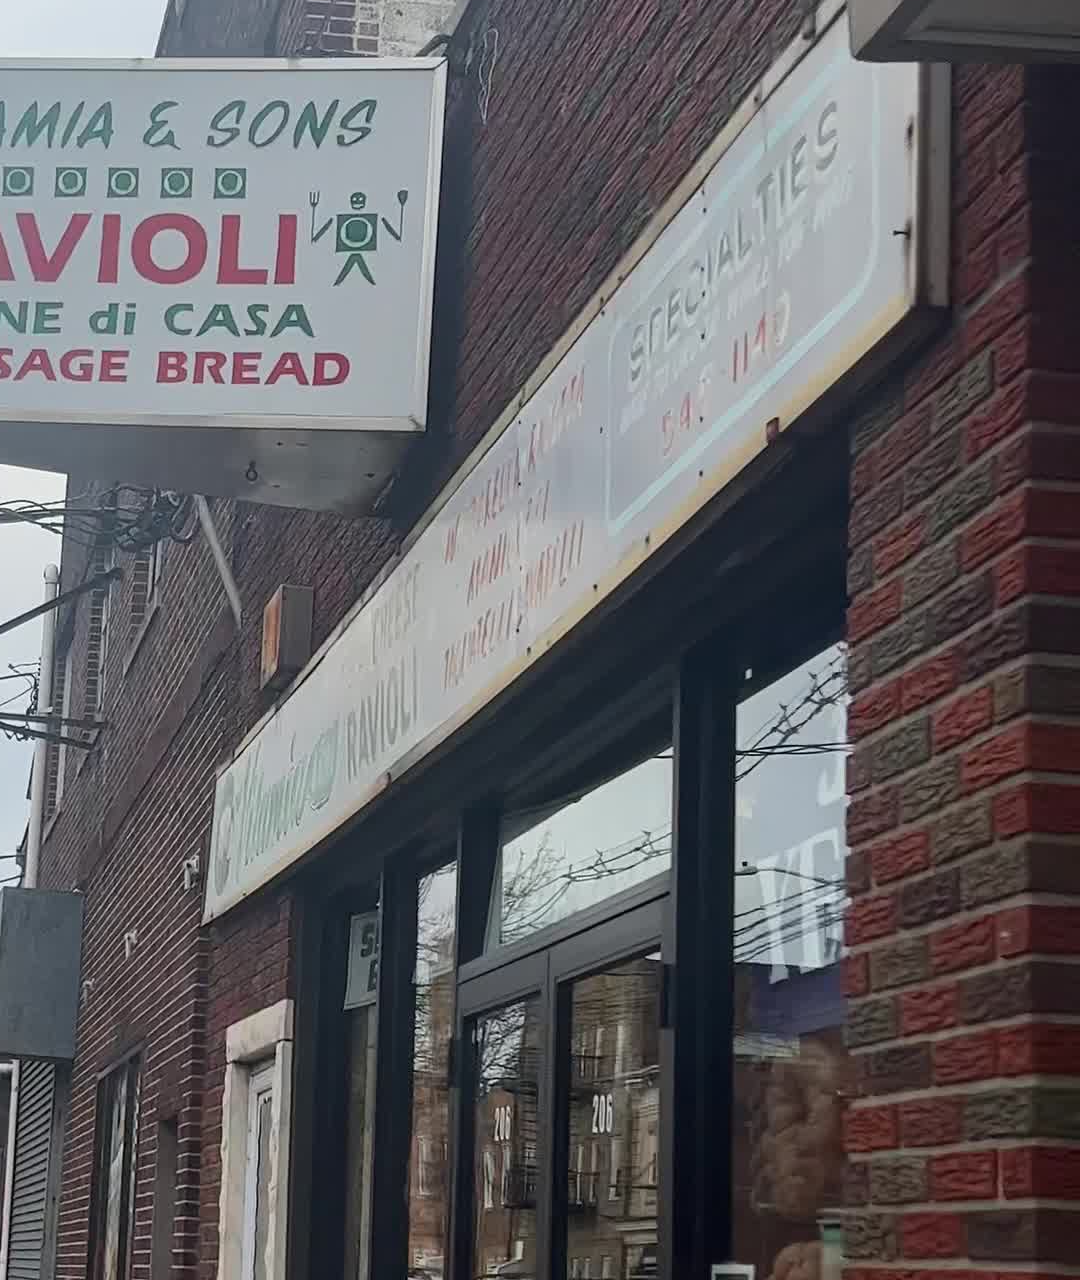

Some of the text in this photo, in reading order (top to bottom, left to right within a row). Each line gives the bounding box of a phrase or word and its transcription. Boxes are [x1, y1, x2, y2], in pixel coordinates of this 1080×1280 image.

[142, 101, 182, 151] &
[206, 99, 378, 150] SONS
[88, 302, 137, 336] di
[163, 302, 316, 339] CASA
[155, 350, 351, 388] BREAD
[494, 1105, 512, 1142] 206
[592, 1093, 613, 1134] 206
